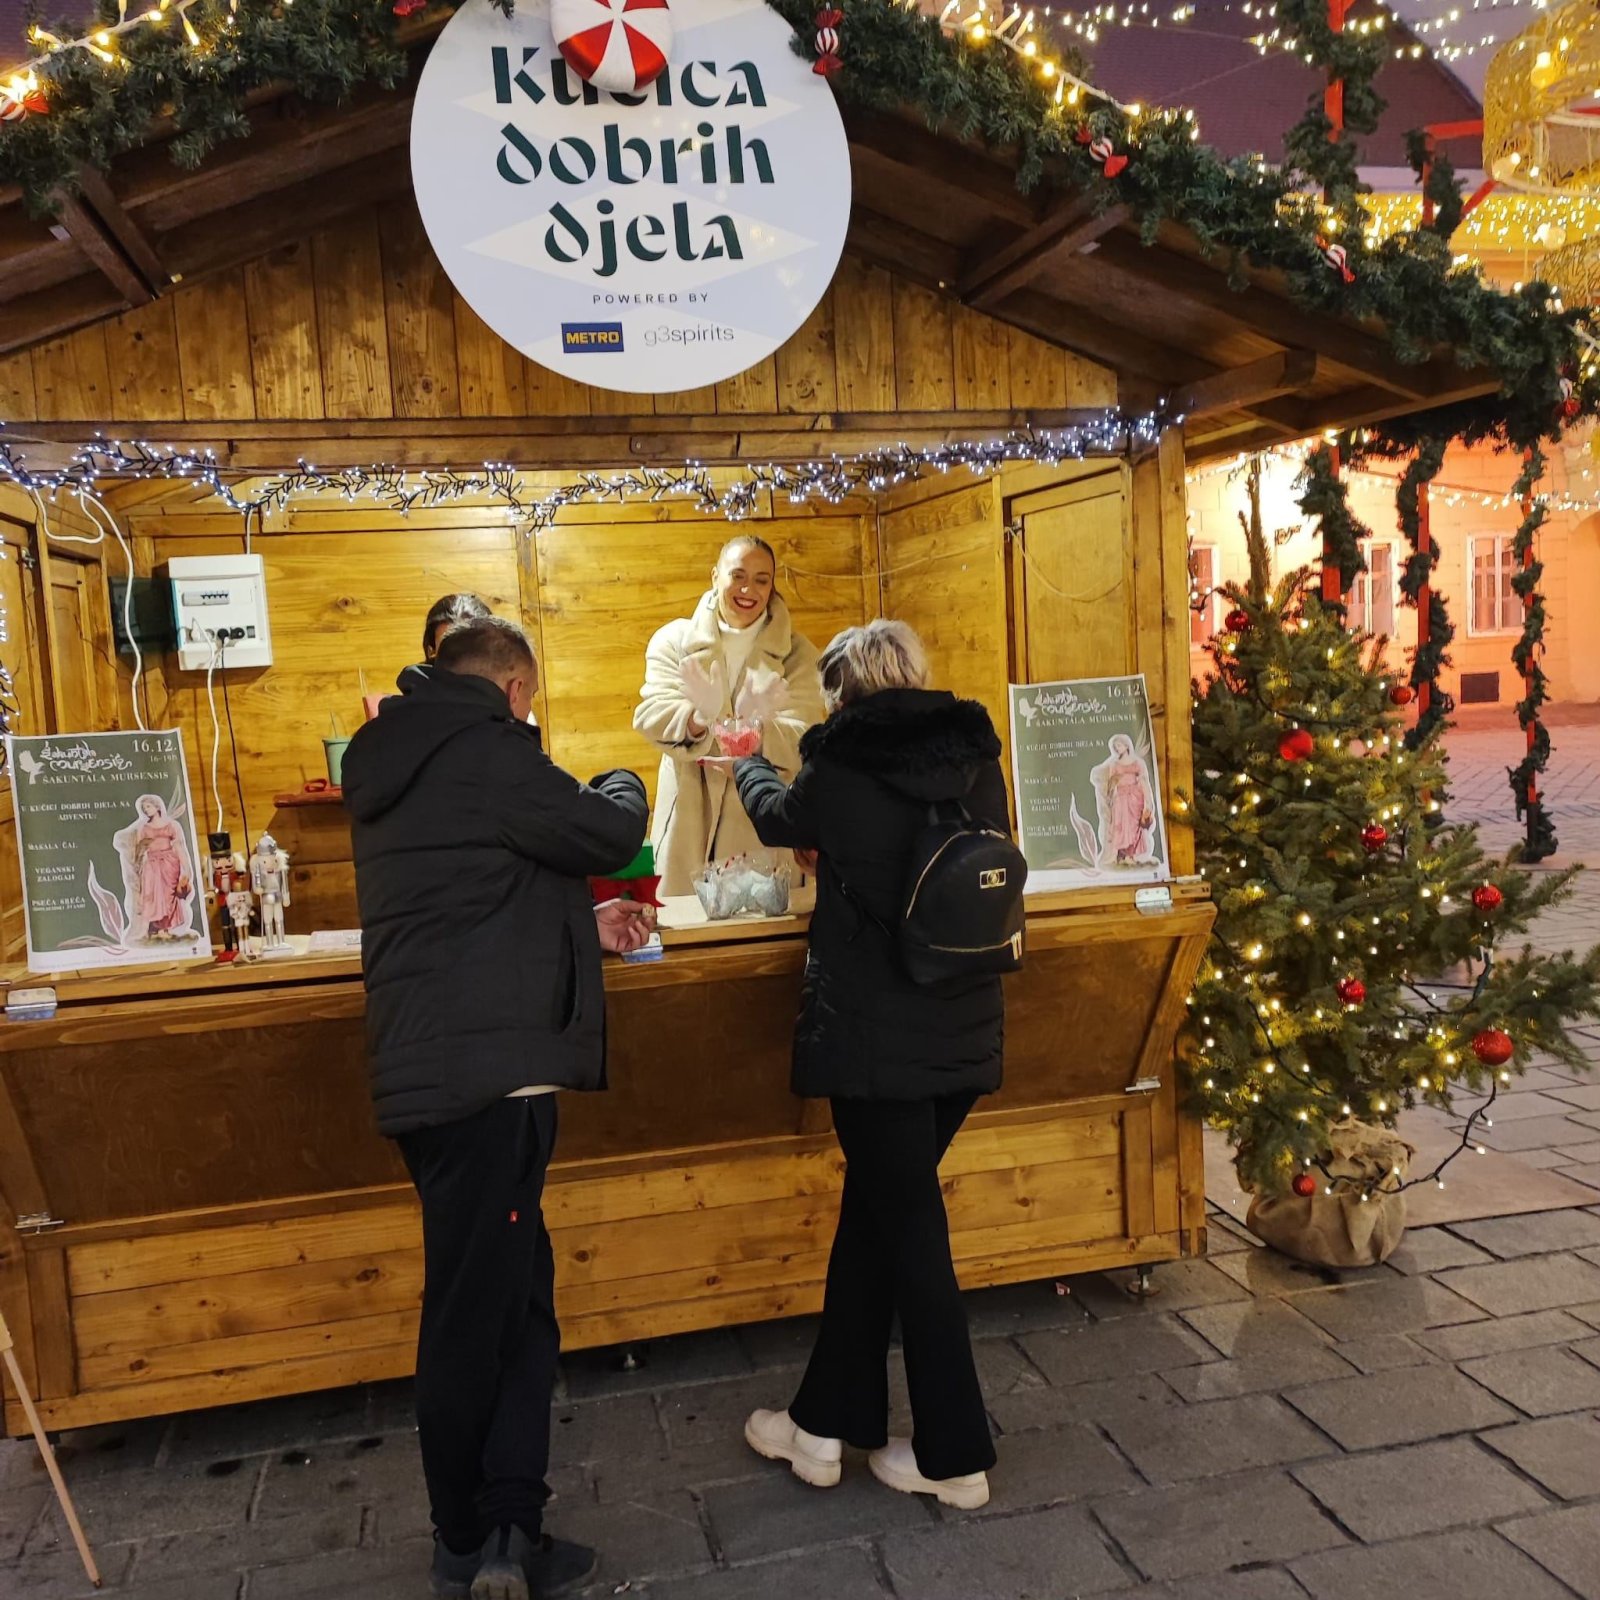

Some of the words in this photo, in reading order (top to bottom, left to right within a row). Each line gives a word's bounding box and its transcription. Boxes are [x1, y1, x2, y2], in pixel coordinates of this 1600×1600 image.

[491, 46, 767, 107] Kuica
[496, 121, 775, 185] dobrih
[544, 198, 744, 277] djela
[593, 293, 678, 304] POWERED
[688, 293, 709, 303] BY
[566, 331, 620, 345] METRO
[644, 323, 735, 348] g3spirits
[132, 738, 177, 753] 16.12.
